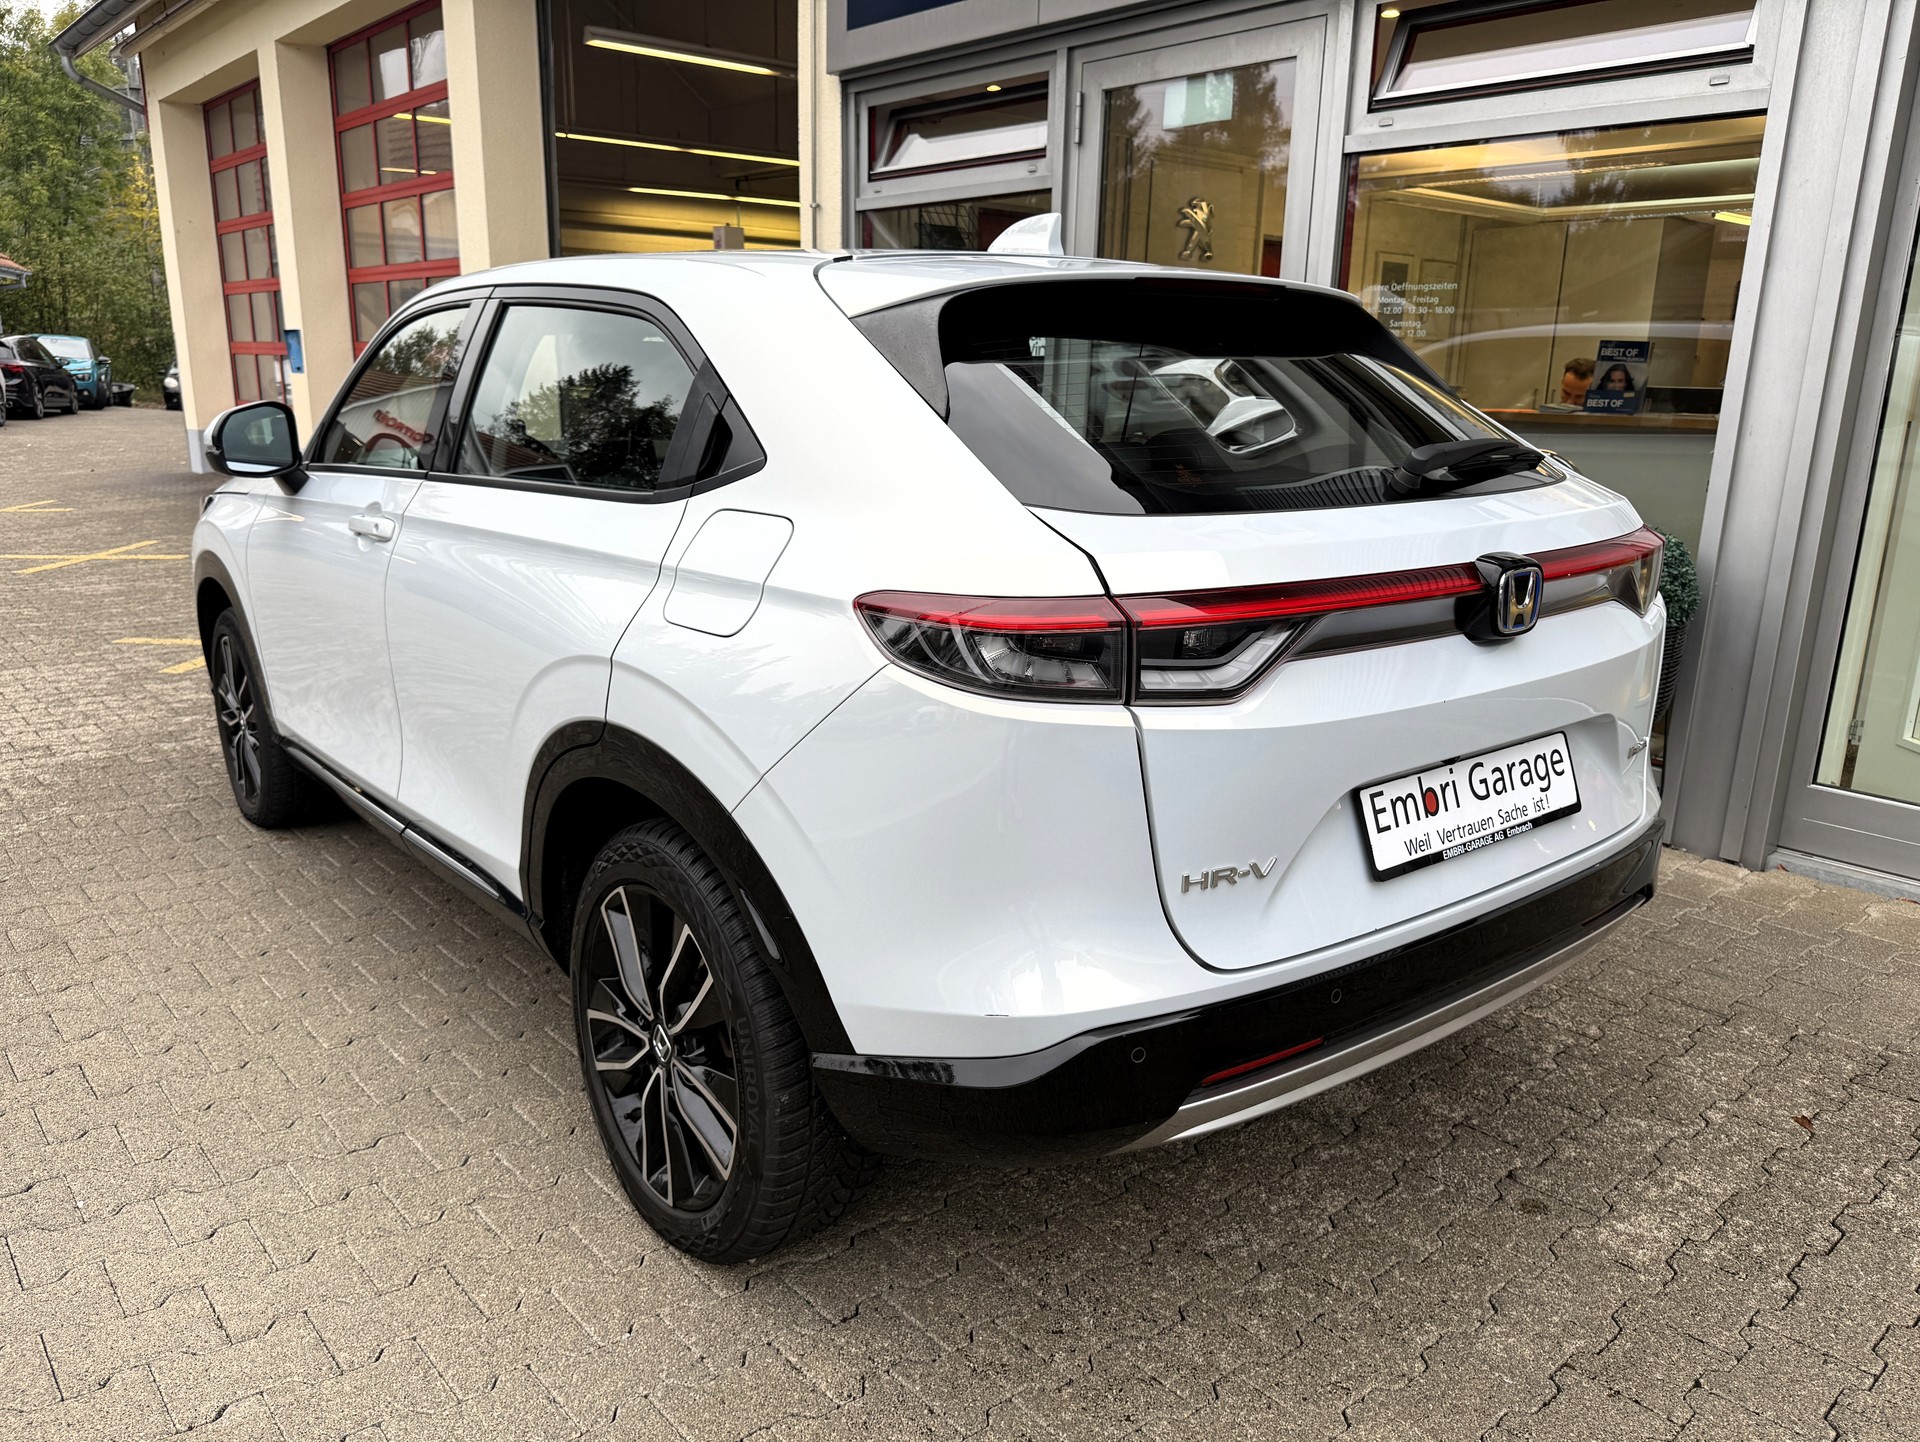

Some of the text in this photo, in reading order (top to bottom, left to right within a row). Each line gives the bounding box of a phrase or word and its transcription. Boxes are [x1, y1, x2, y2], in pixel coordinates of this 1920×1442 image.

[1391, 282, 1458, 293] Oeffnungszeiten
[1377, 296, 1406, 305] Montag
[1412, 295, 1440, 305] Freitag
[1383, 307, 1403, 315] 12.00
[1408, 306, 1428, 314] 13.30
[1435, 306, 1455, 314] 18.00
[1389, 320, 1421, 329] Samstag
[1407, 329, 1426, 337] 12.00
[1600, 347, 1639, 357] BEST OF
[1586, 398, 1624, 407] BEST OF
[1369, 748, 1566, 834] Embri Garage
[1404, 832, 1432, 857] Weil
[1436, 815, 1495, 845] Vertrauen
[1497, 803, 1529, 825] Sache
[1442, 821, 1533, 860] EMBRI-GARAGE AG Embrach
[1181, 856, 1278, 893] HR-V
[736, 1017, 760, 1150] UNIROYAL
